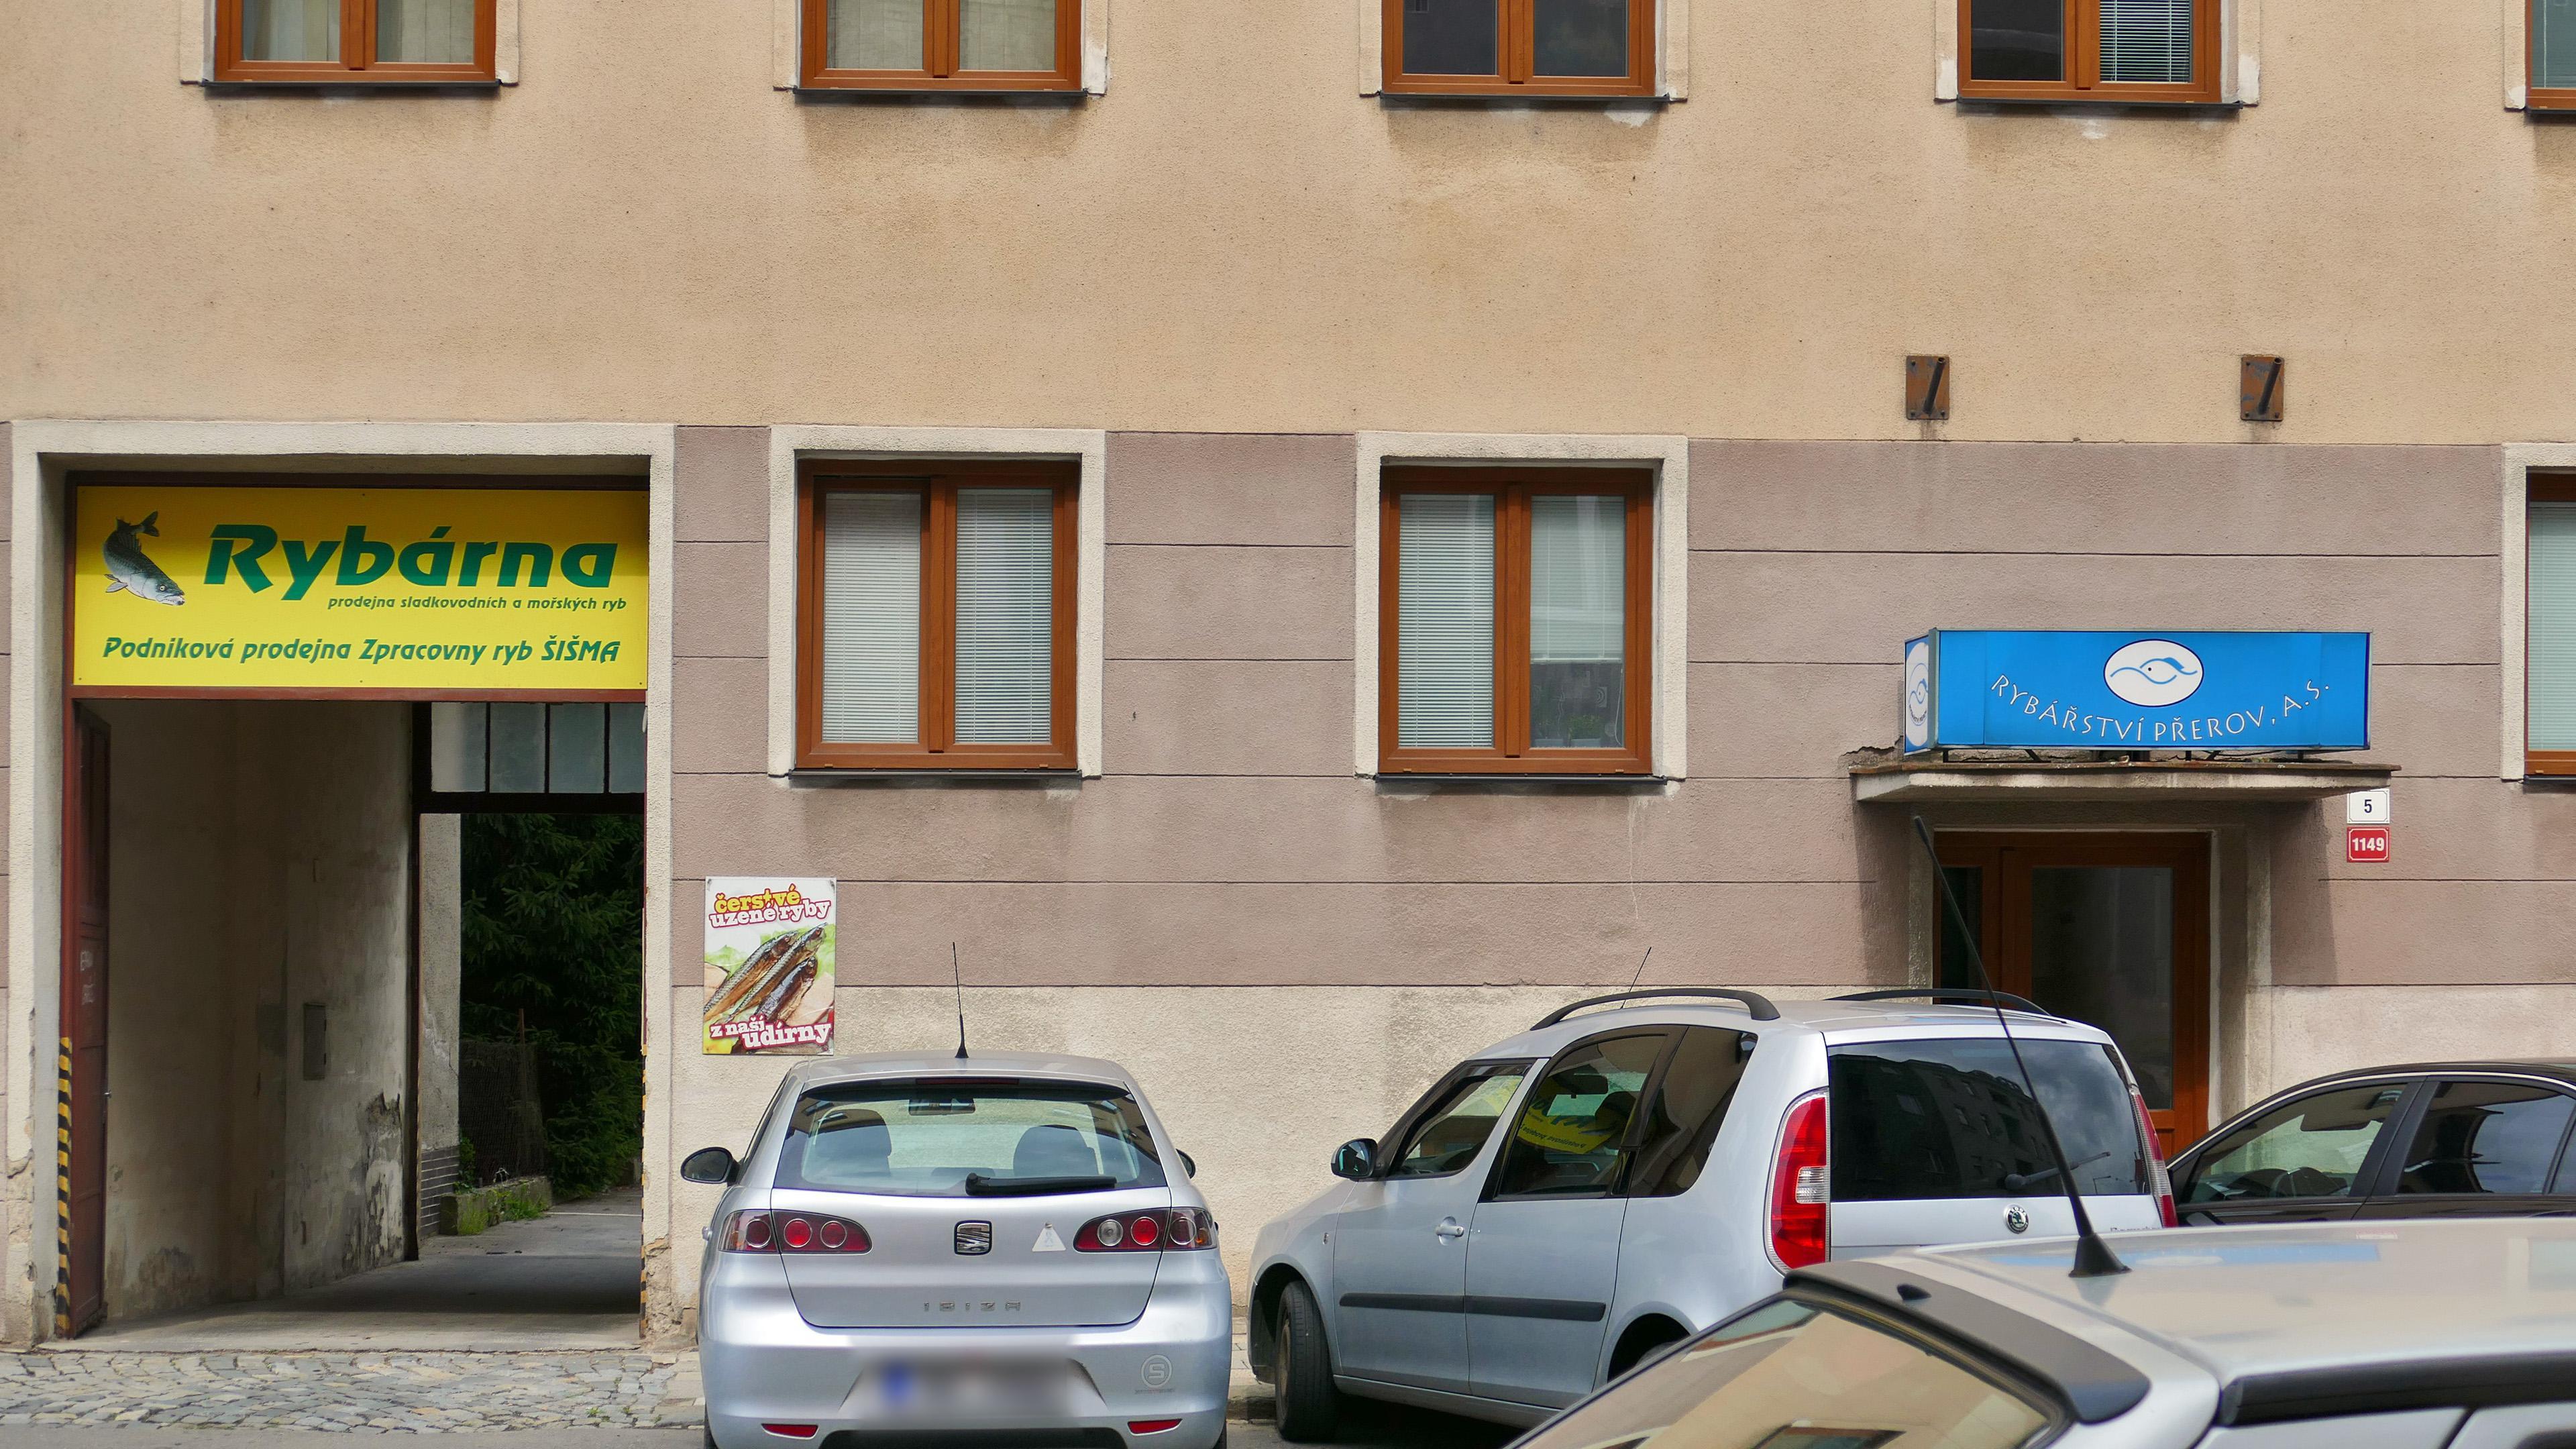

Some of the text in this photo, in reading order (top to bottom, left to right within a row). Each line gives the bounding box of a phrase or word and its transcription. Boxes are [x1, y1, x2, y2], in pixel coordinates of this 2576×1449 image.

[204, 524, 619, 601] Rybárna
[327, 596, 627, 612] prodejna sladkovodních a mořských ryb
[103, 635, 621, 665] Podniková prodejna Zpracovny ryb ŠIŠMA
[1990, 674, 2330, 742] RYBÁŘSTVÍ PŘEROV, A.S.
[2364, 799, 2373, 814] 5
[2352, 837, 2385, 852] 1149
[709, 898, 831, 928] uzené ryby
[714, 883, 801, 914] čerstvé
[709, 1014, 765, 1039] z naší
[740, 1020, 832, 1050] udírny
[924, 1300, 1021, 1312] IBIZA
